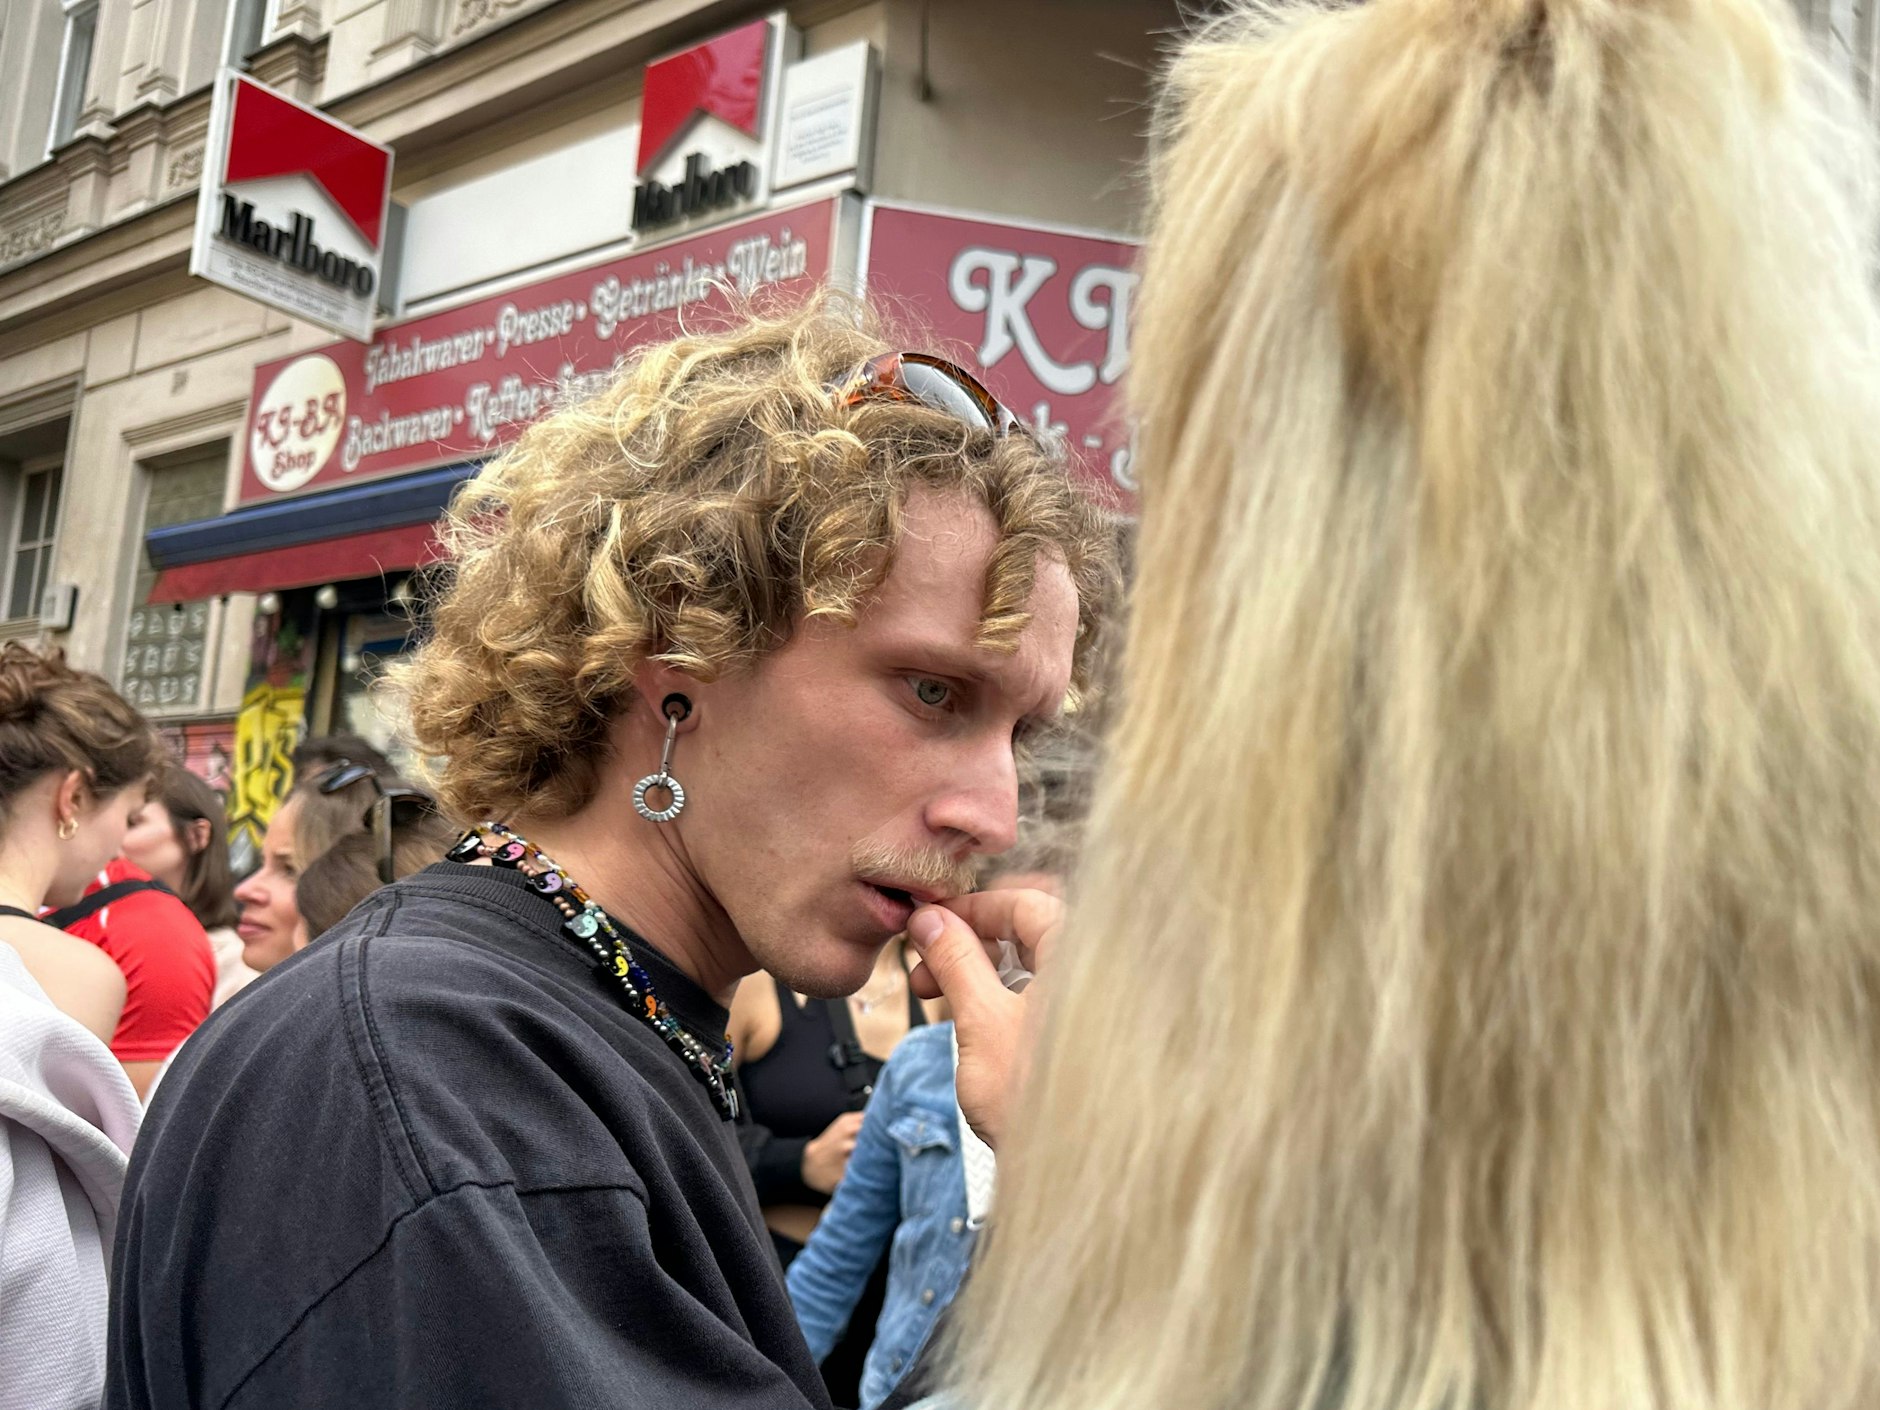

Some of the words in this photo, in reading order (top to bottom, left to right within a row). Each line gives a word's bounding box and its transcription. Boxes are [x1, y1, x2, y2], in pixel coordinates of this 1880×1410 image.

[215, 191, 375, 297] Marlboro
[364, 329, 485, 394] Tabakwaren
[496, 299, 575, 358] Presse
[727, 227, 806, 294] Wein
[271, 450, 317, 479] Shop
[341, 407, 454, 472] Backwaren
